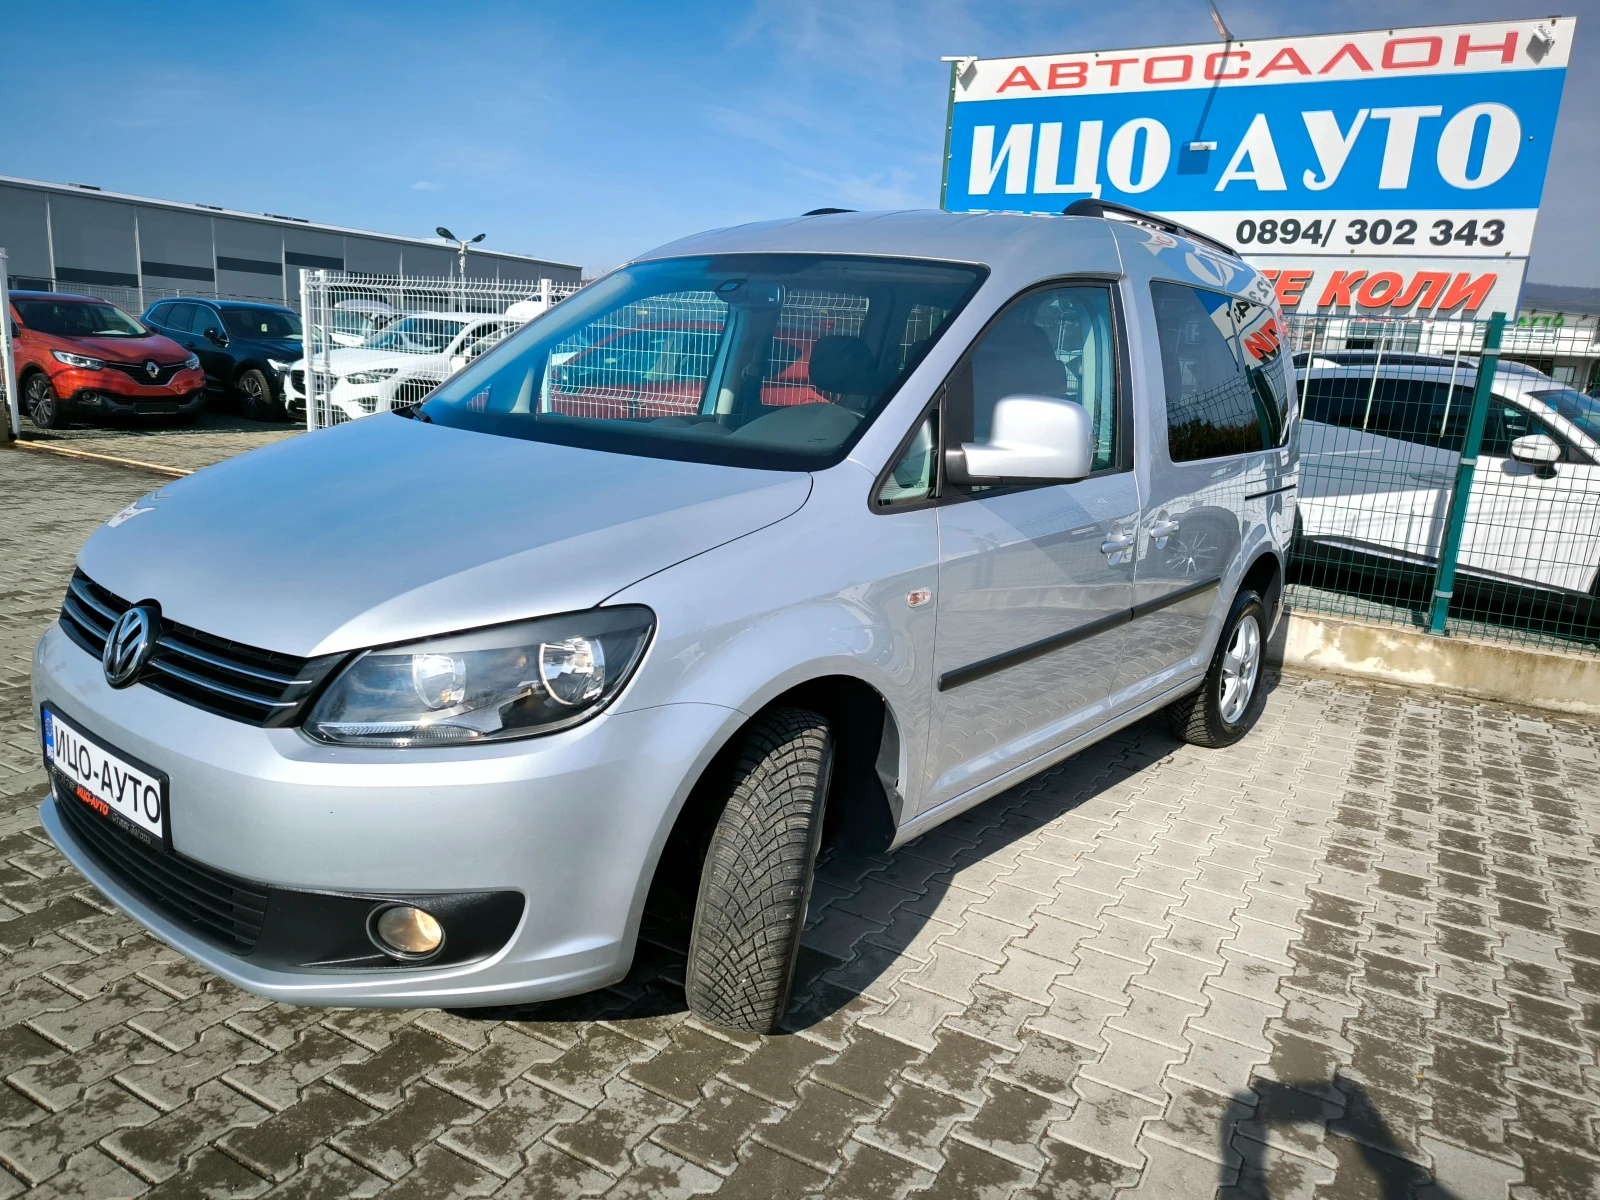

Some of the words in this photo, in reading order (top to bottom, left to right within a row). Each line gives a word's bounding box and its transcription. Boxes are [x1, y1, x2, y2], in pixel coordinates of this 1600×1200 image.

[996, 31, 1519, 93] АВТОСАЛОН
[1236, 219, 1336, 248] 0894/
[1345, 219, 1418, 245] 302
[1429, 219, 1505, 246] 343
[1317, 270, 1498, 310] КОЛИ
[55, 726, 160, 823] ИЦО-АУТО
[76, 784, 109, 816] ИЦО-АУТО
